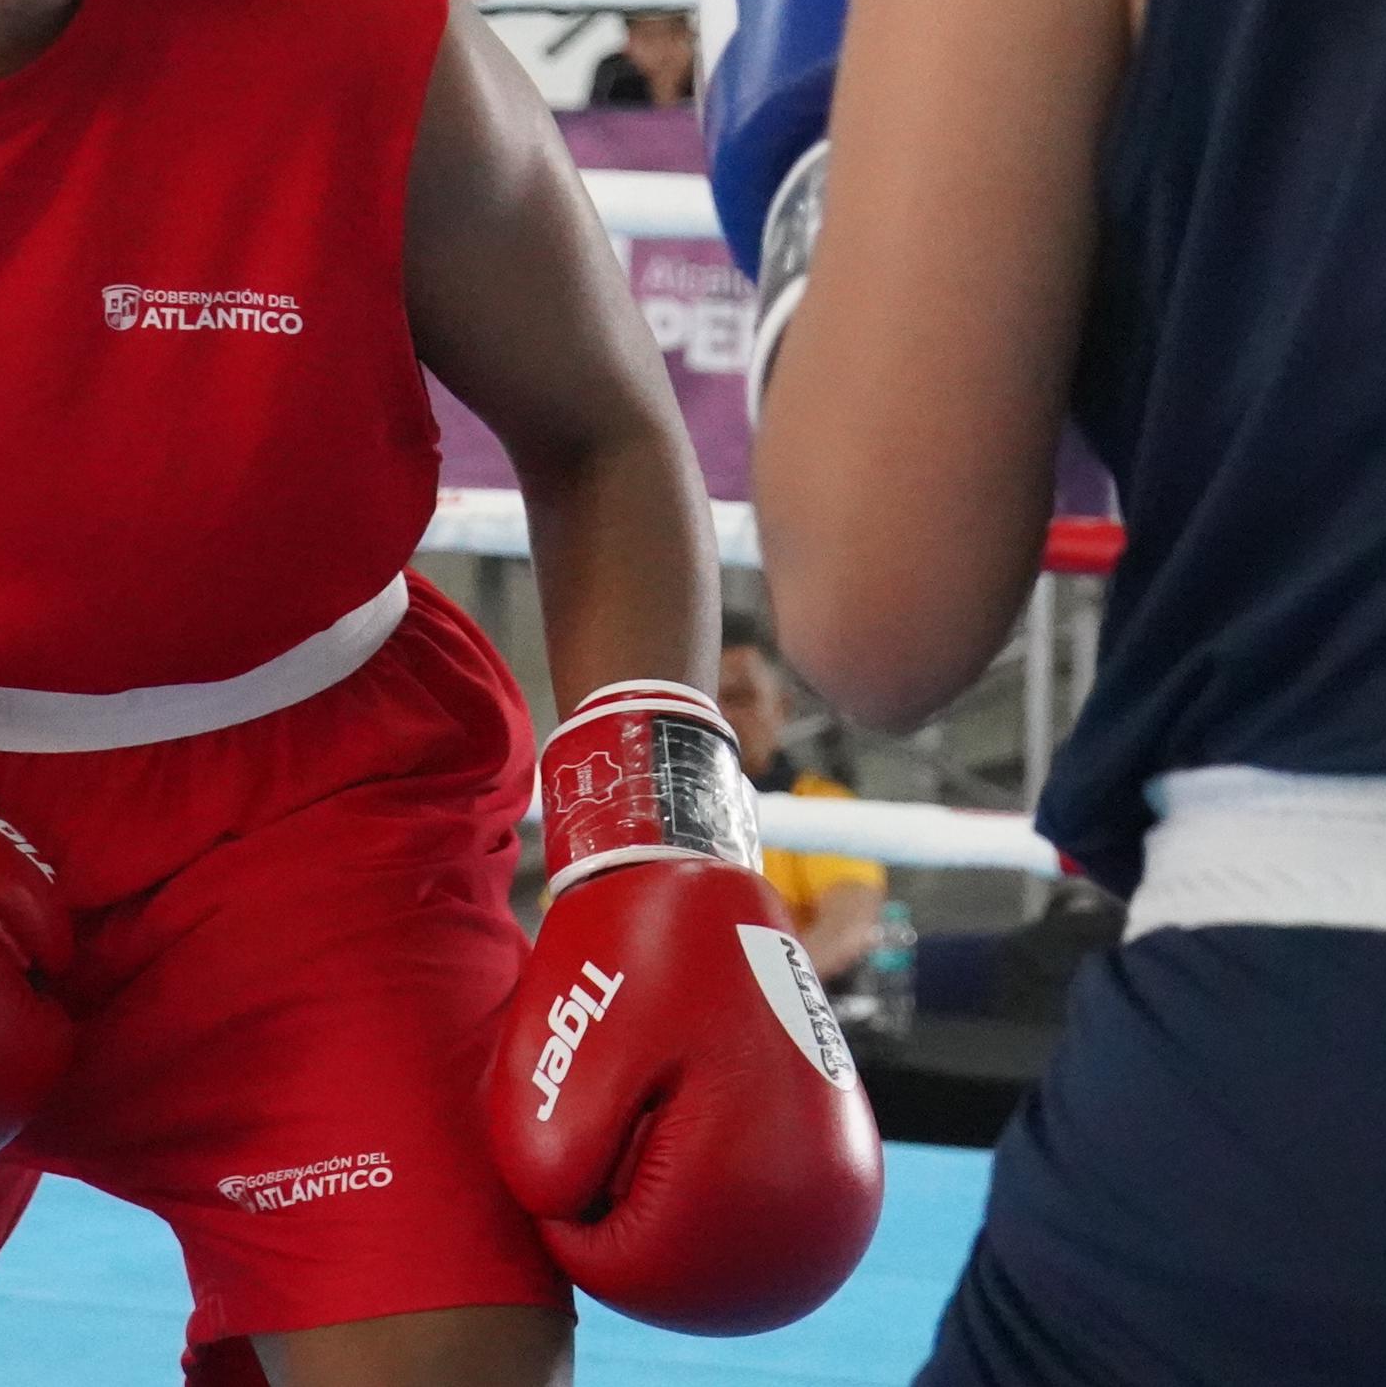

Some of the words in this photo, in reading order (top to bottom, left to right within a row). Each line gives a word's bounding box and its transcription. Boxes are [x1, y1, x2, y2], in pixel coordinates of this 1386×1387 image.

[142, 288, 264, 306] GOBERNACIÓN
[268, 294, 301, 309] DEL
[141, 304, 303, 335] ATLÁNTICO
[531, 959, 626, 1123] Tiger
[246, 1155, 352, 1189] GOBERNACIÓN
[357, 1152, 391, 1167] DEL
[254, 1166, 394, 1211] ATLÁNTICO
